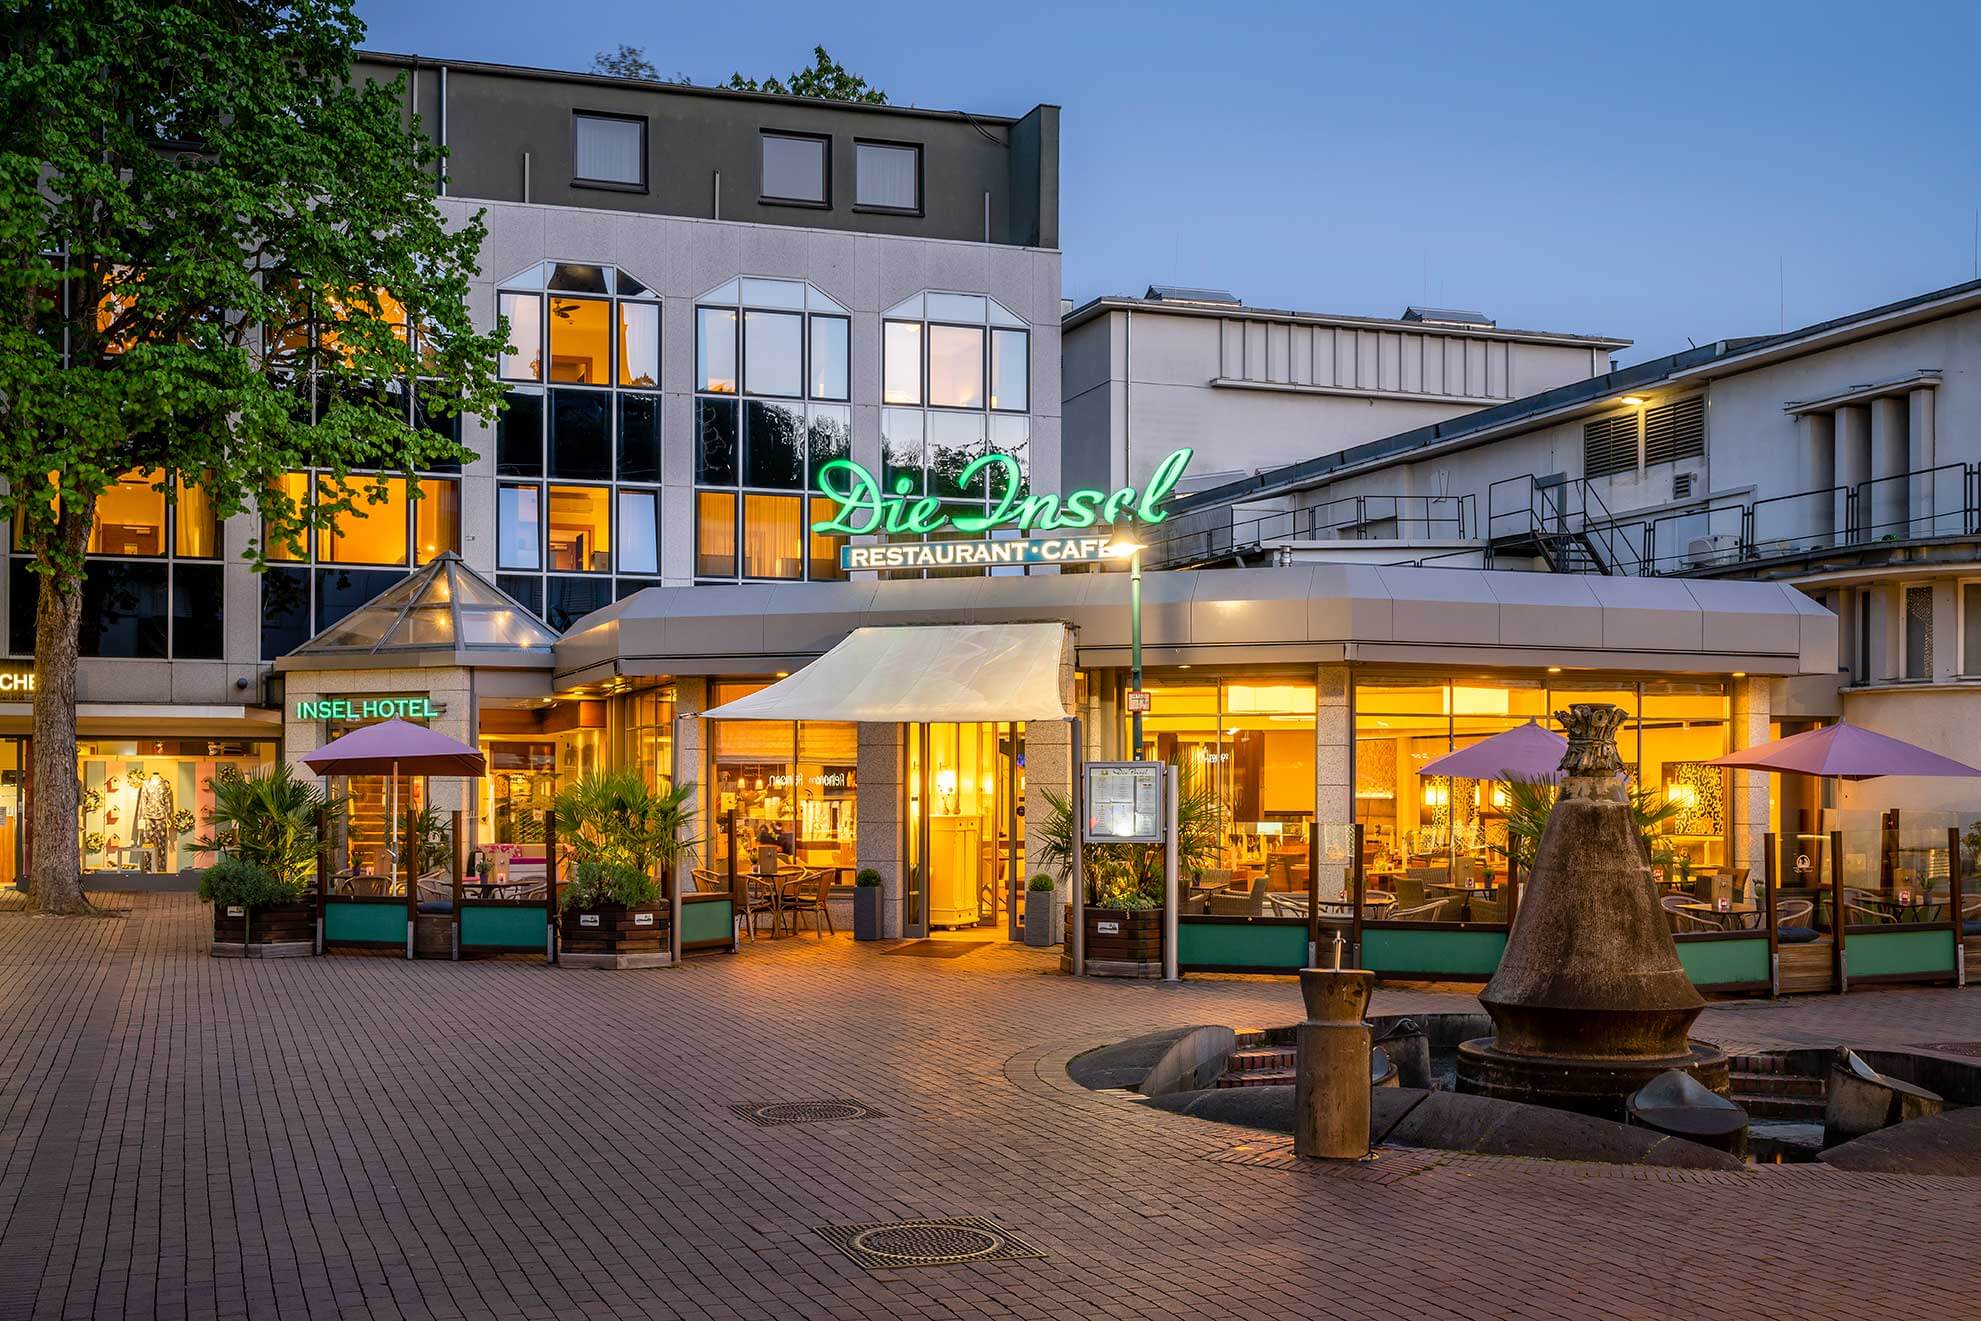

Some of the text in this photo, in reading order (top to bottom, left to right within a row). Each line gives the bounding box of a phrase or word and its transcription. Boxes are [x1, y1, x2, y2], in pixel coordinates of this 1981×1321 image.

[811, 447, 1194, 534] Die Insel
[850, 541, 1029, 568] RESTAURANT
[296, 698, 438, 719] INSEL HOTEL
